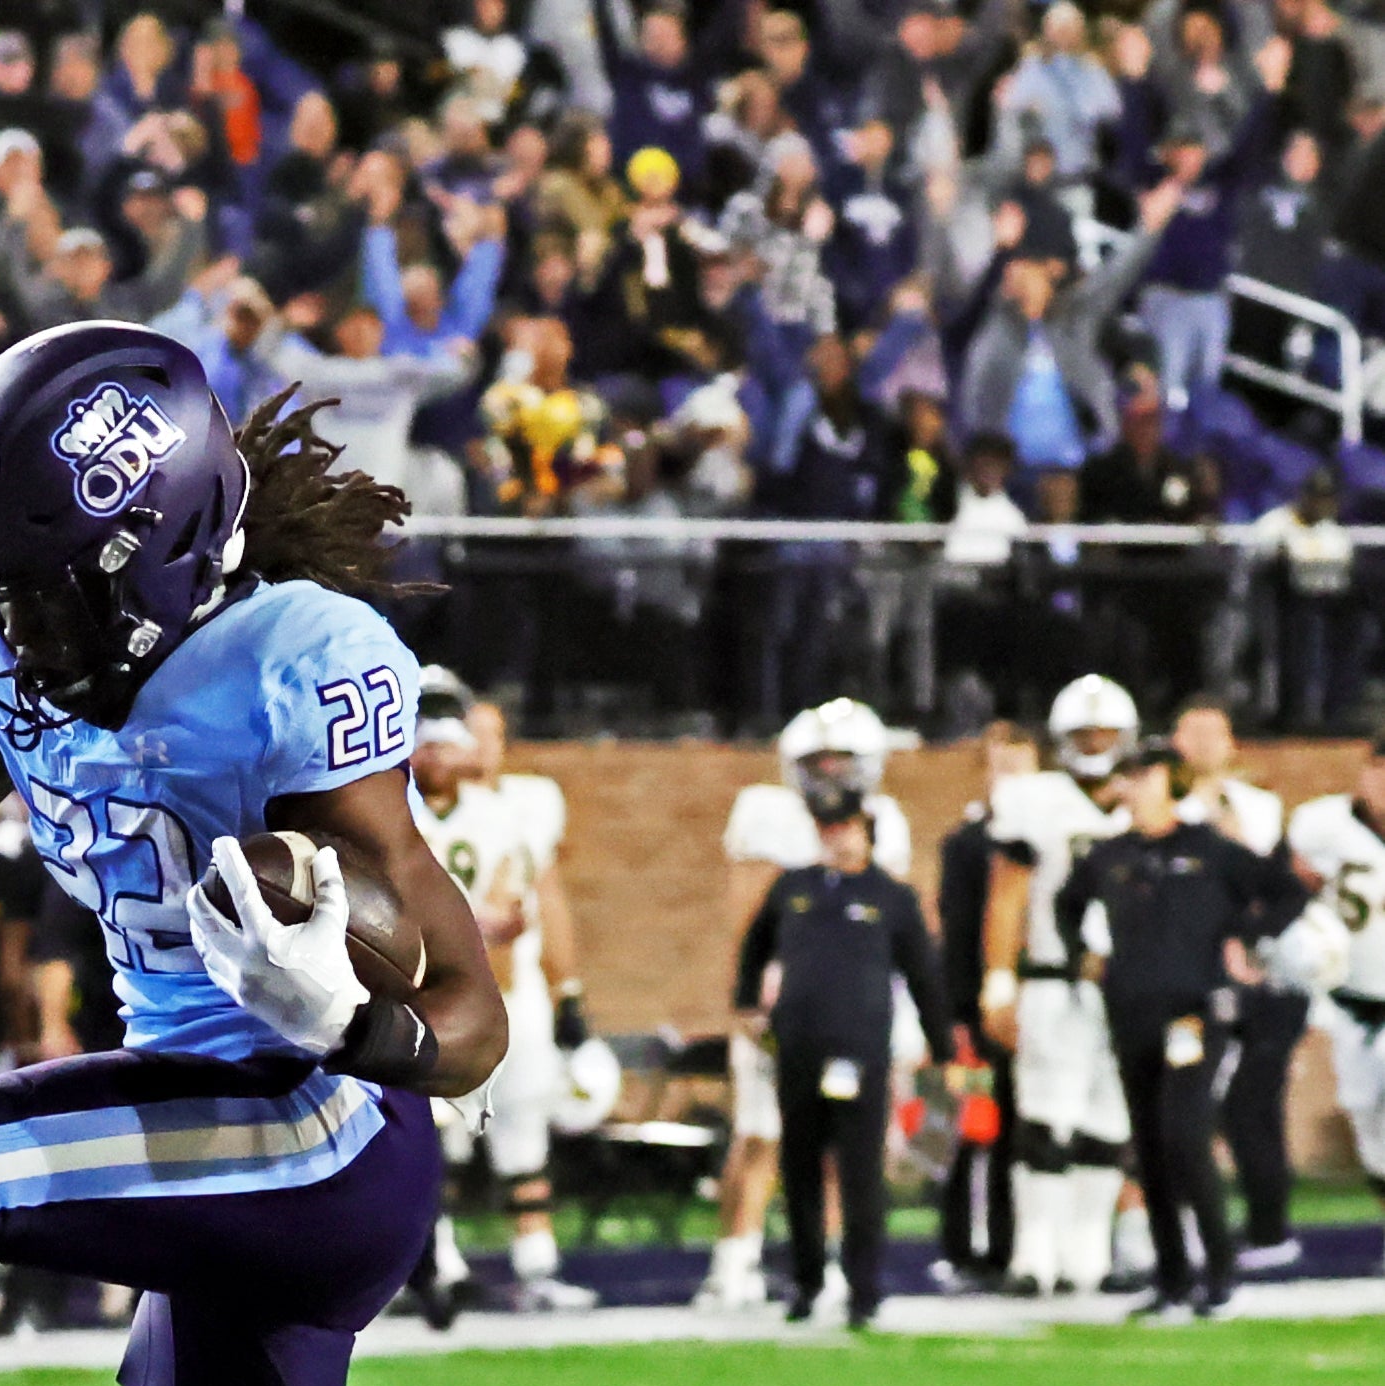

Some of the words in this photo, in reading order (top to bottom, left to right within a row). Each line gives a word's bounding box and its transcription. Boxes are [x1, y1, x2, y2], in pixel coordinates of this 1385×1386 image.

[81, 405, 184, 510] ODU
[318, 665, 406, 771] 22
[28, 774, 212, 975] 22
